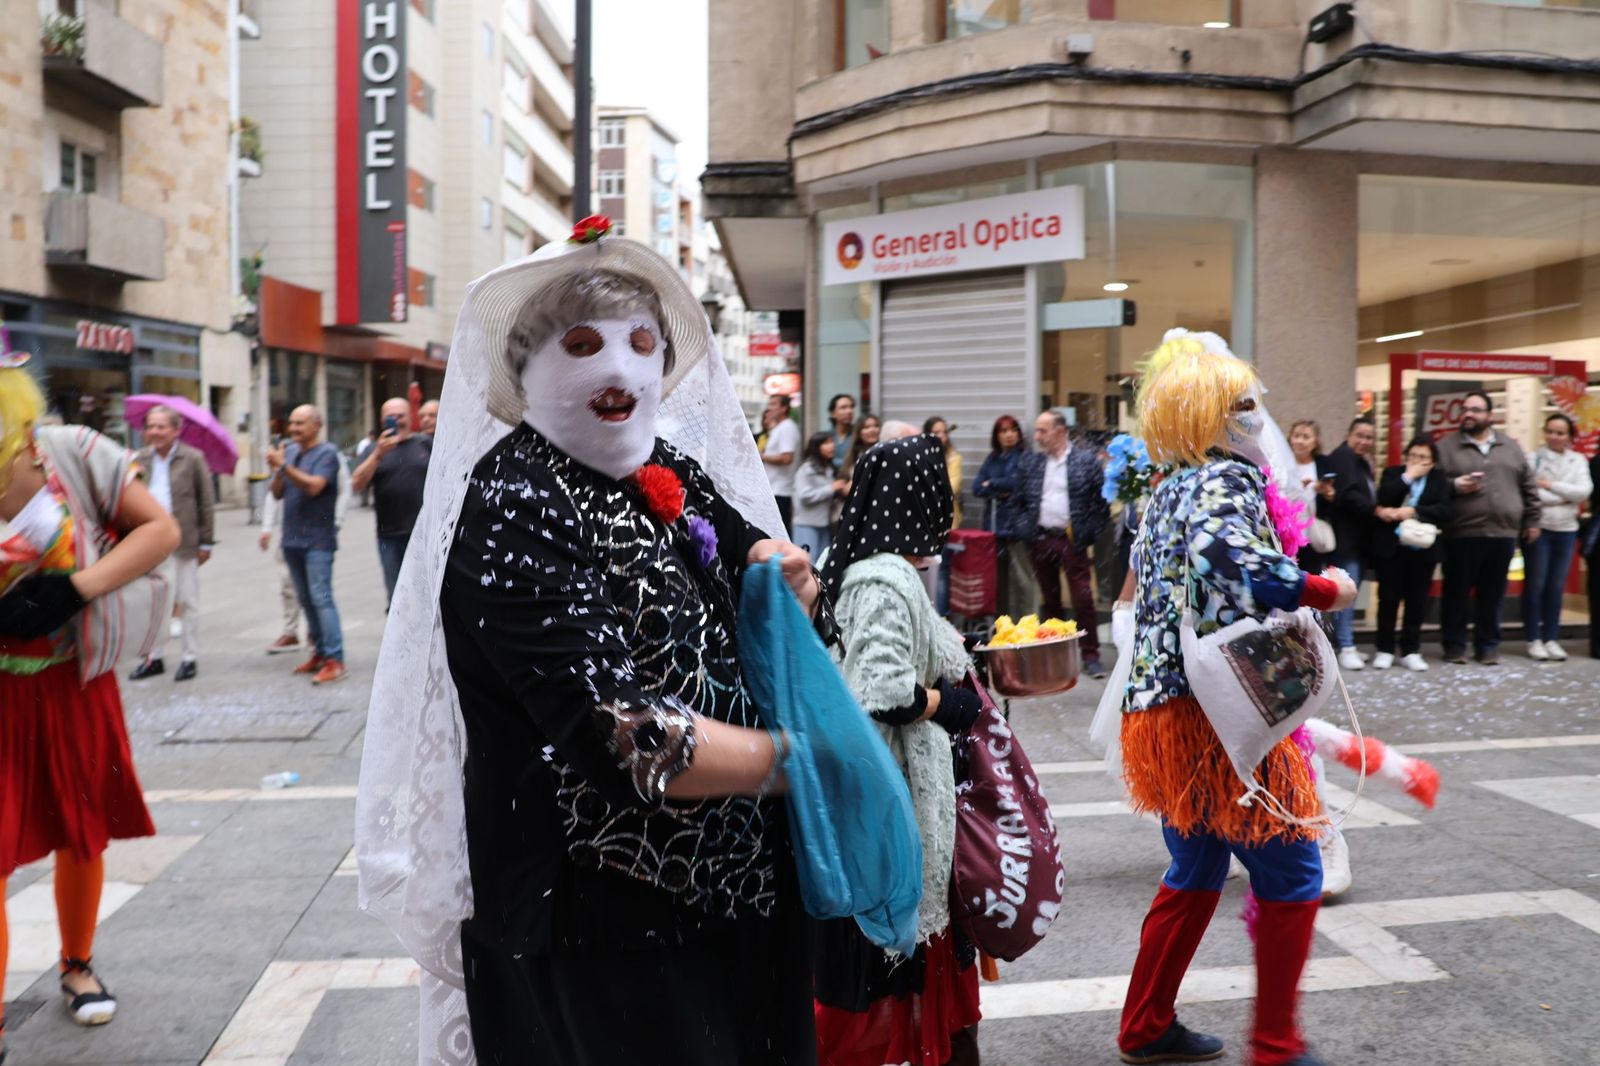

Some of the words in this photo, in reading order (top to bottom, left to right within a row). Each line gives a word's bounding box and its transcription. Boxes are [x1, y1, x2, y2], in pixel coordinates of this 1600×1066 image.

[362, 1, 399, 211] HOTEL
[872, 223, 966, 259] General
[973, 212, 1061, 251] Optica
